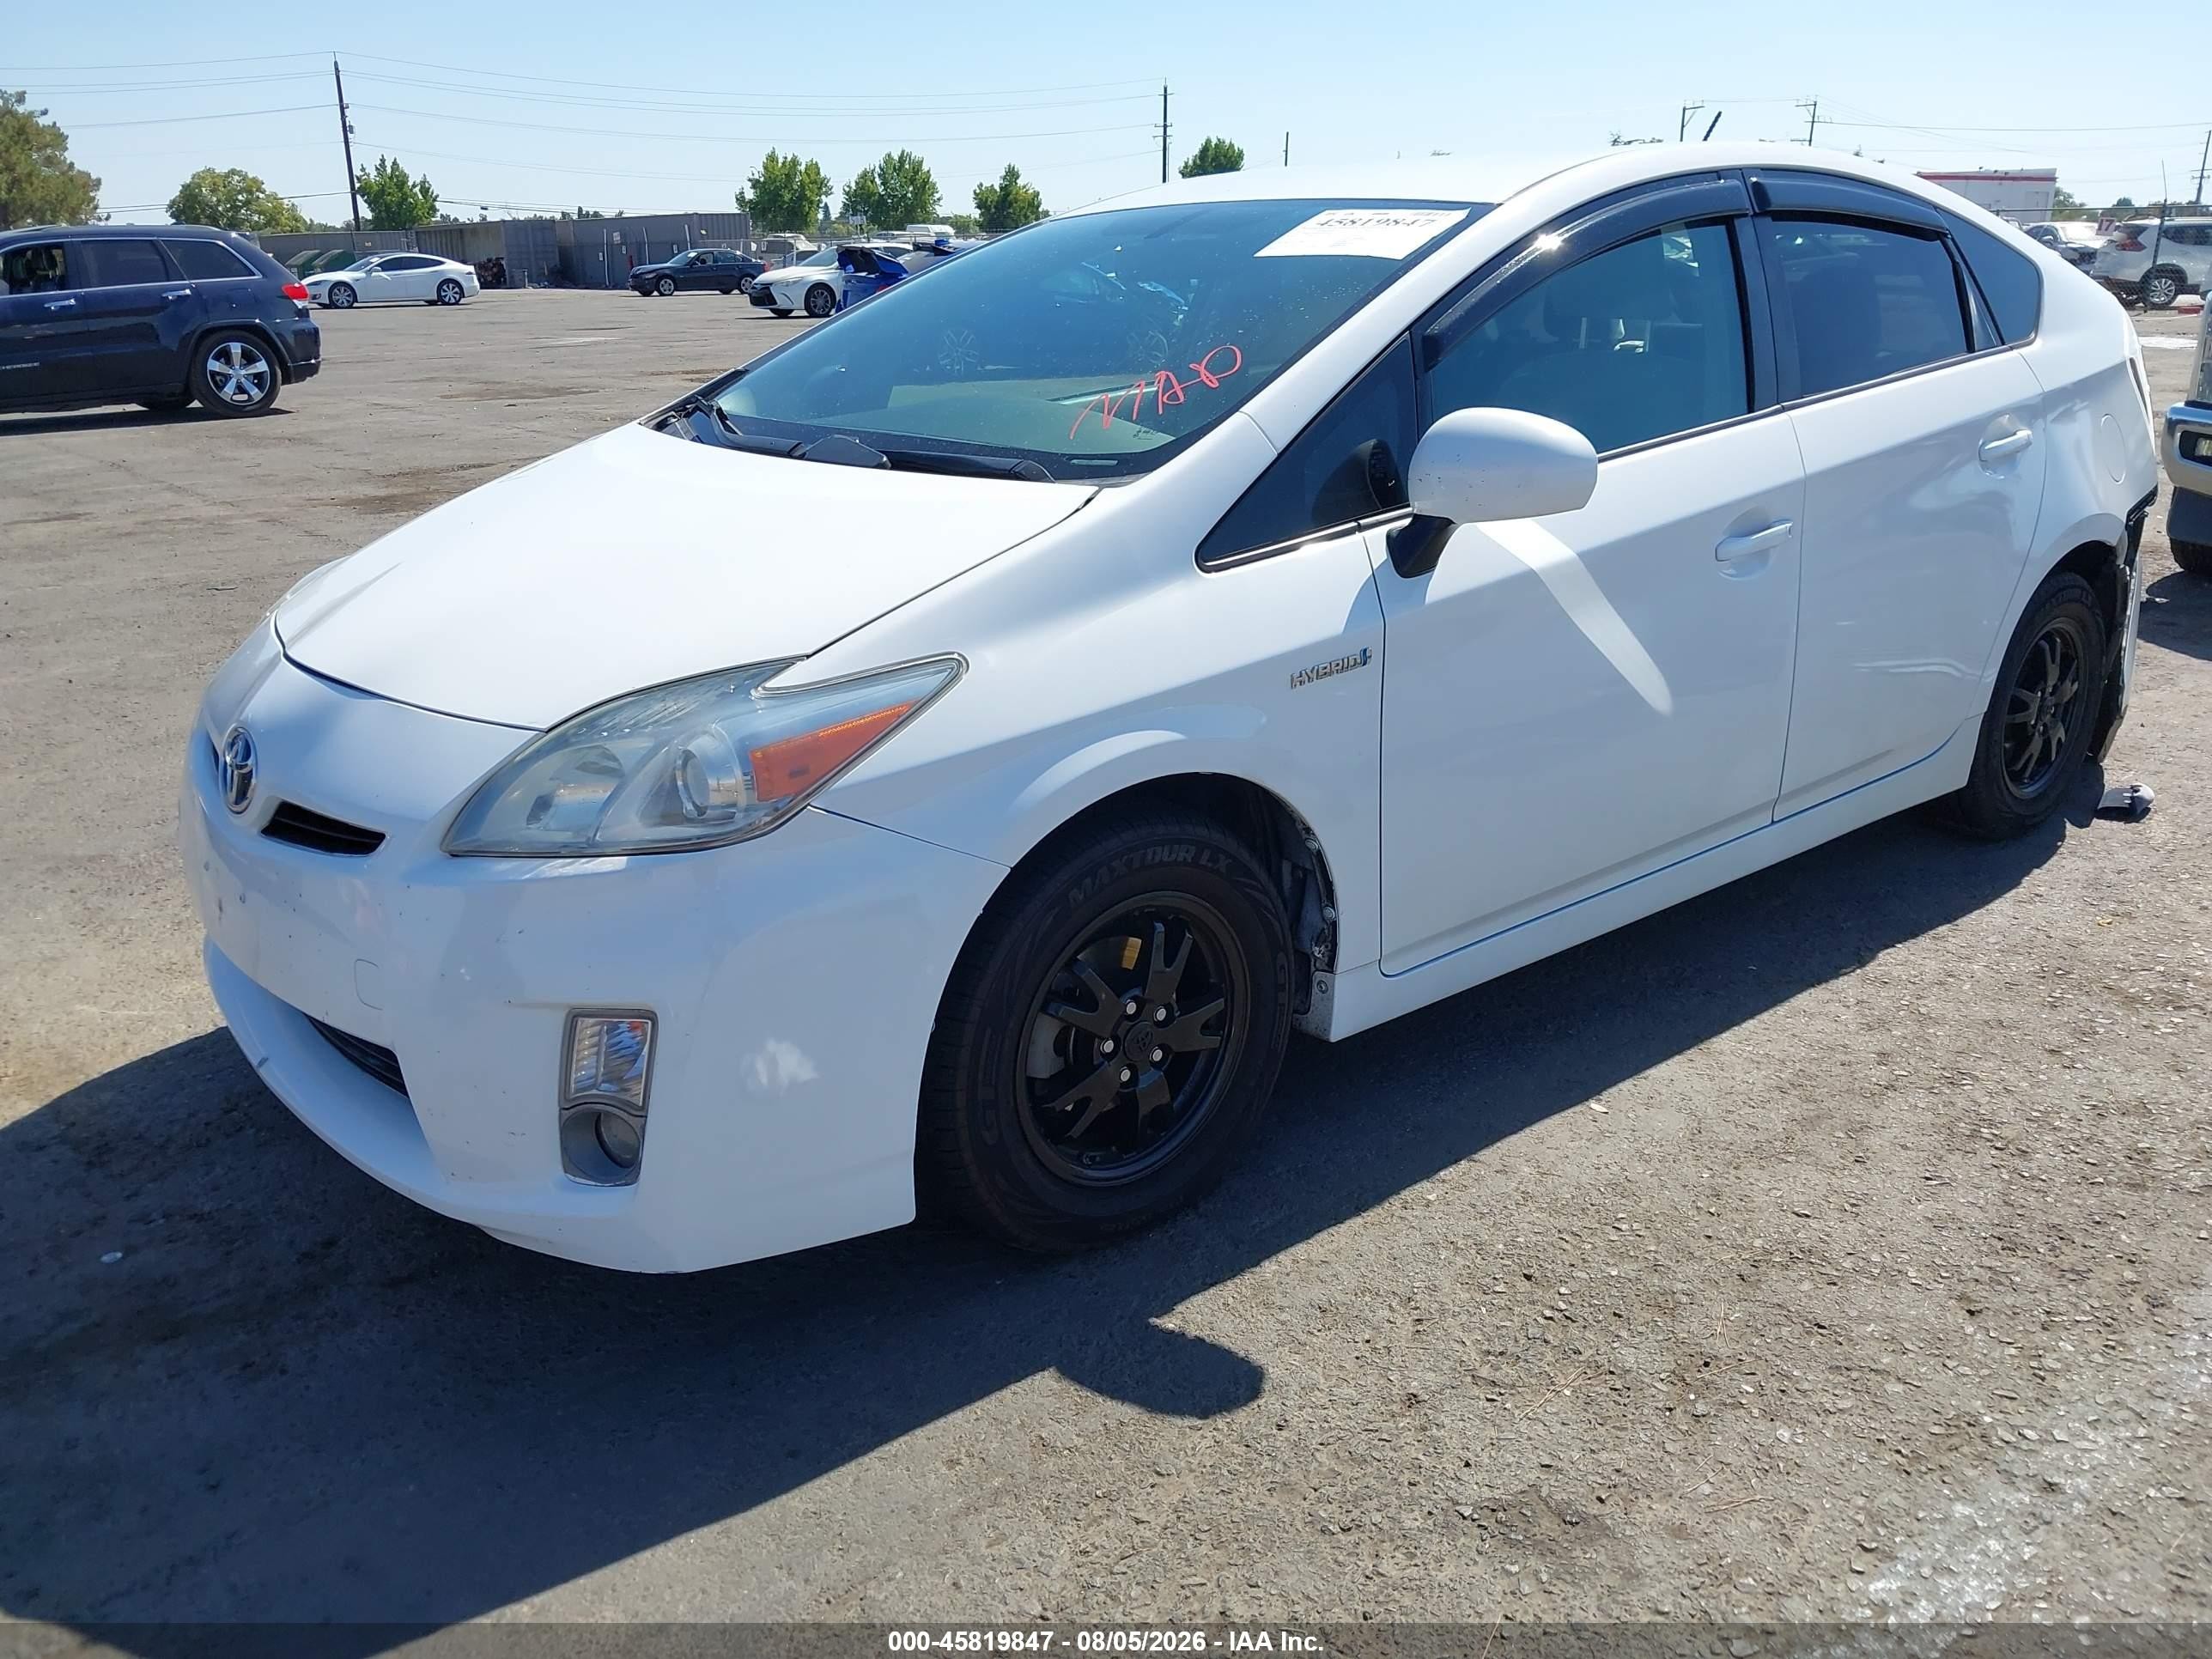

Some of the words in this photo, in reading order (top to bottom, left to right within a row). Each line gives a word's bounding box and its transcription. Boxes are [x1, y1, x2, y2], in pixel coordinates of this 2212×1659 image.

[1316, 218, 1437, 227] 45819847
[2097, 219, 2115, 231] 17
[1291, 654, 1362, 689] HYBRID
[1068, 844, 1196, 904] MAXTOUR
[1200, 848, 1232, 873] LX
